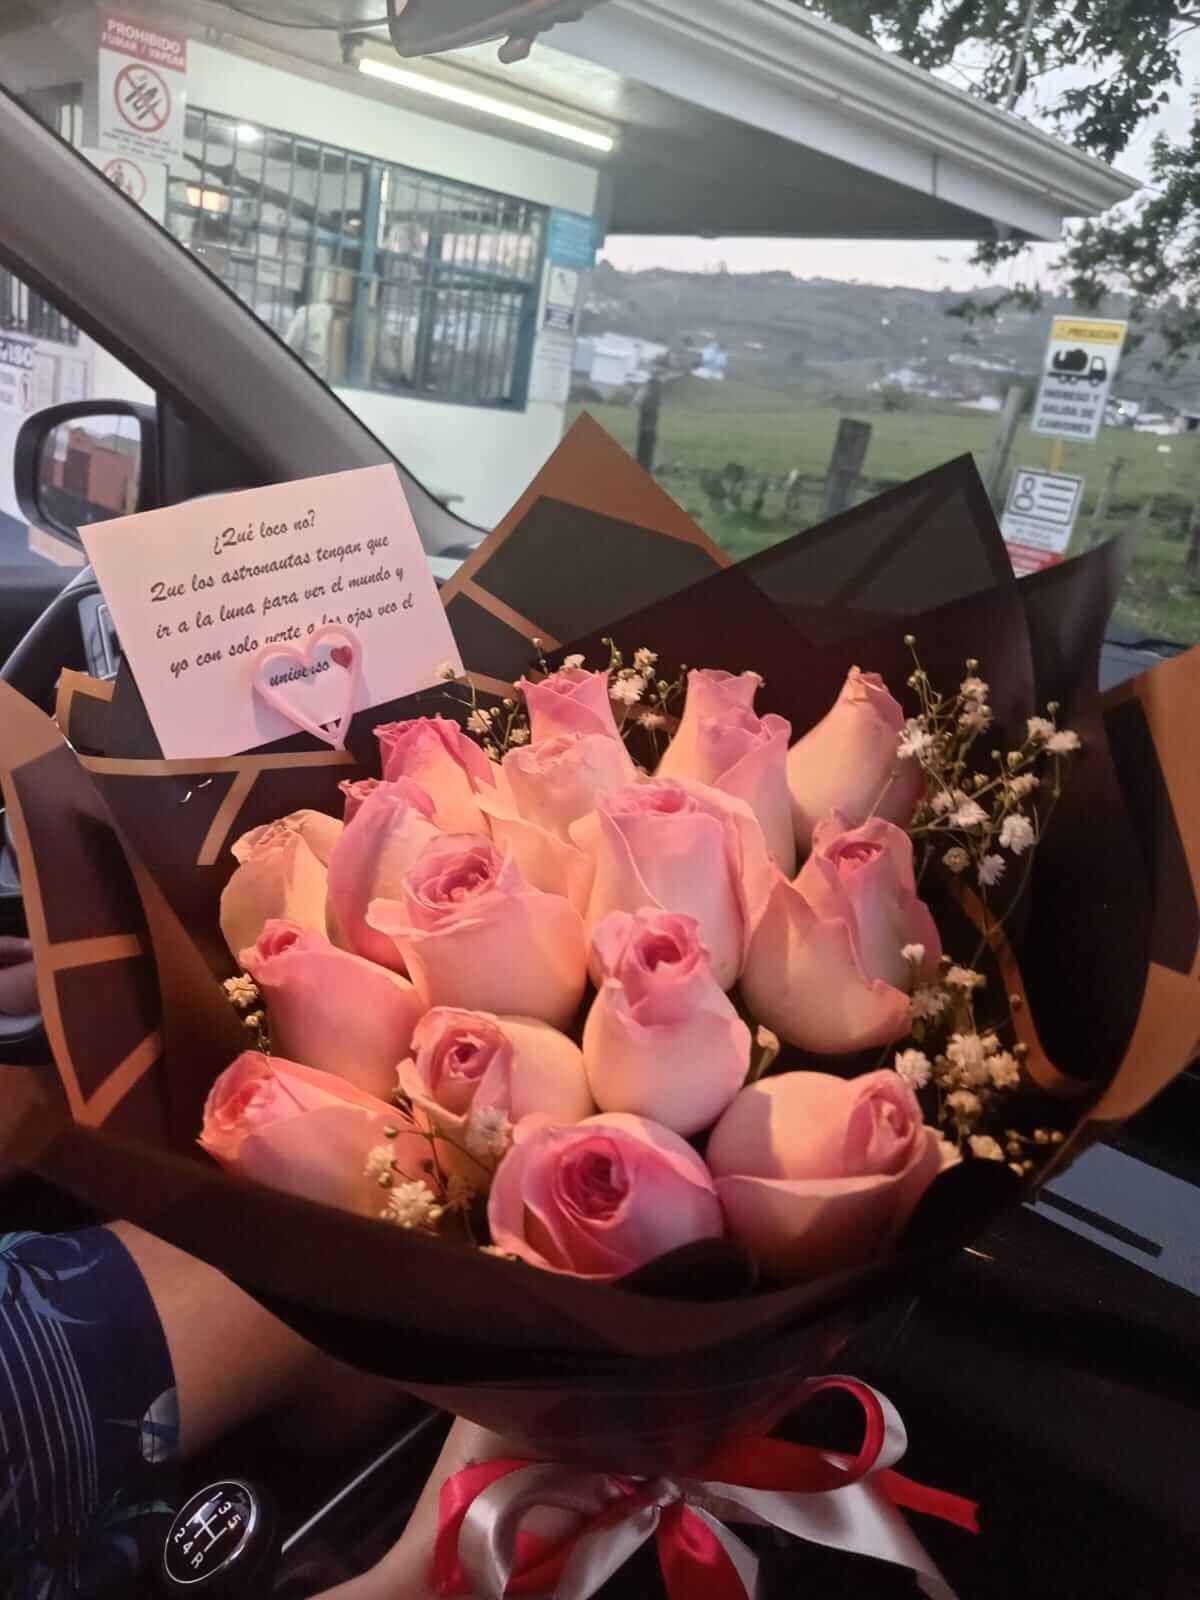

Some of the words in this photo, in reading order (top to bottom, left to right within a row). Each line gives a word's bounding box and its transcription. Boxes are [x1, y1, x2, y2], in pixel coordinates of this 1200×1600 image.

[107, 19, 181, 54] PROHIBIDO
[213, 523, 255, 555] ¿Qué
[260, 522, 288, 539] loco
[294, 509, 315, 530] no?
[150, 581, 185, 602] Que
[191, 574, 215, 591] los
[222, 552, 311, 584] astronautas
[316, 543, 361, 562] tengan
[367, 535, 389, 555] que
[156, 624, 171, 639] ir
[178, 620, 189, 633] a
[196, 611, 214, 628] la
[220, 603, 255, 622] luna
[263, 592, 299, 615] para
[304, 585, 326, 600] ver
[331, 576, 344, 592] el
[348, 567, 391, 588] mundo
[396, 568, 404, 582] y
[170, 658, 189, 679] yo
[196, 650, 223, 666] con
[228, 635, 258, 656] solo
[347, 607, 373, 628] ojos
[378, 602, 398, 616] veo
[402, 592, 414, 609] el
[218, 1501, 232, 1514] 3
[227, 1514, 241, 1529] 5
[174, 1527, 186, 1543] 2
[182, 1541, 194, 1555] 4
[191, 1552, 204, 1569] R
